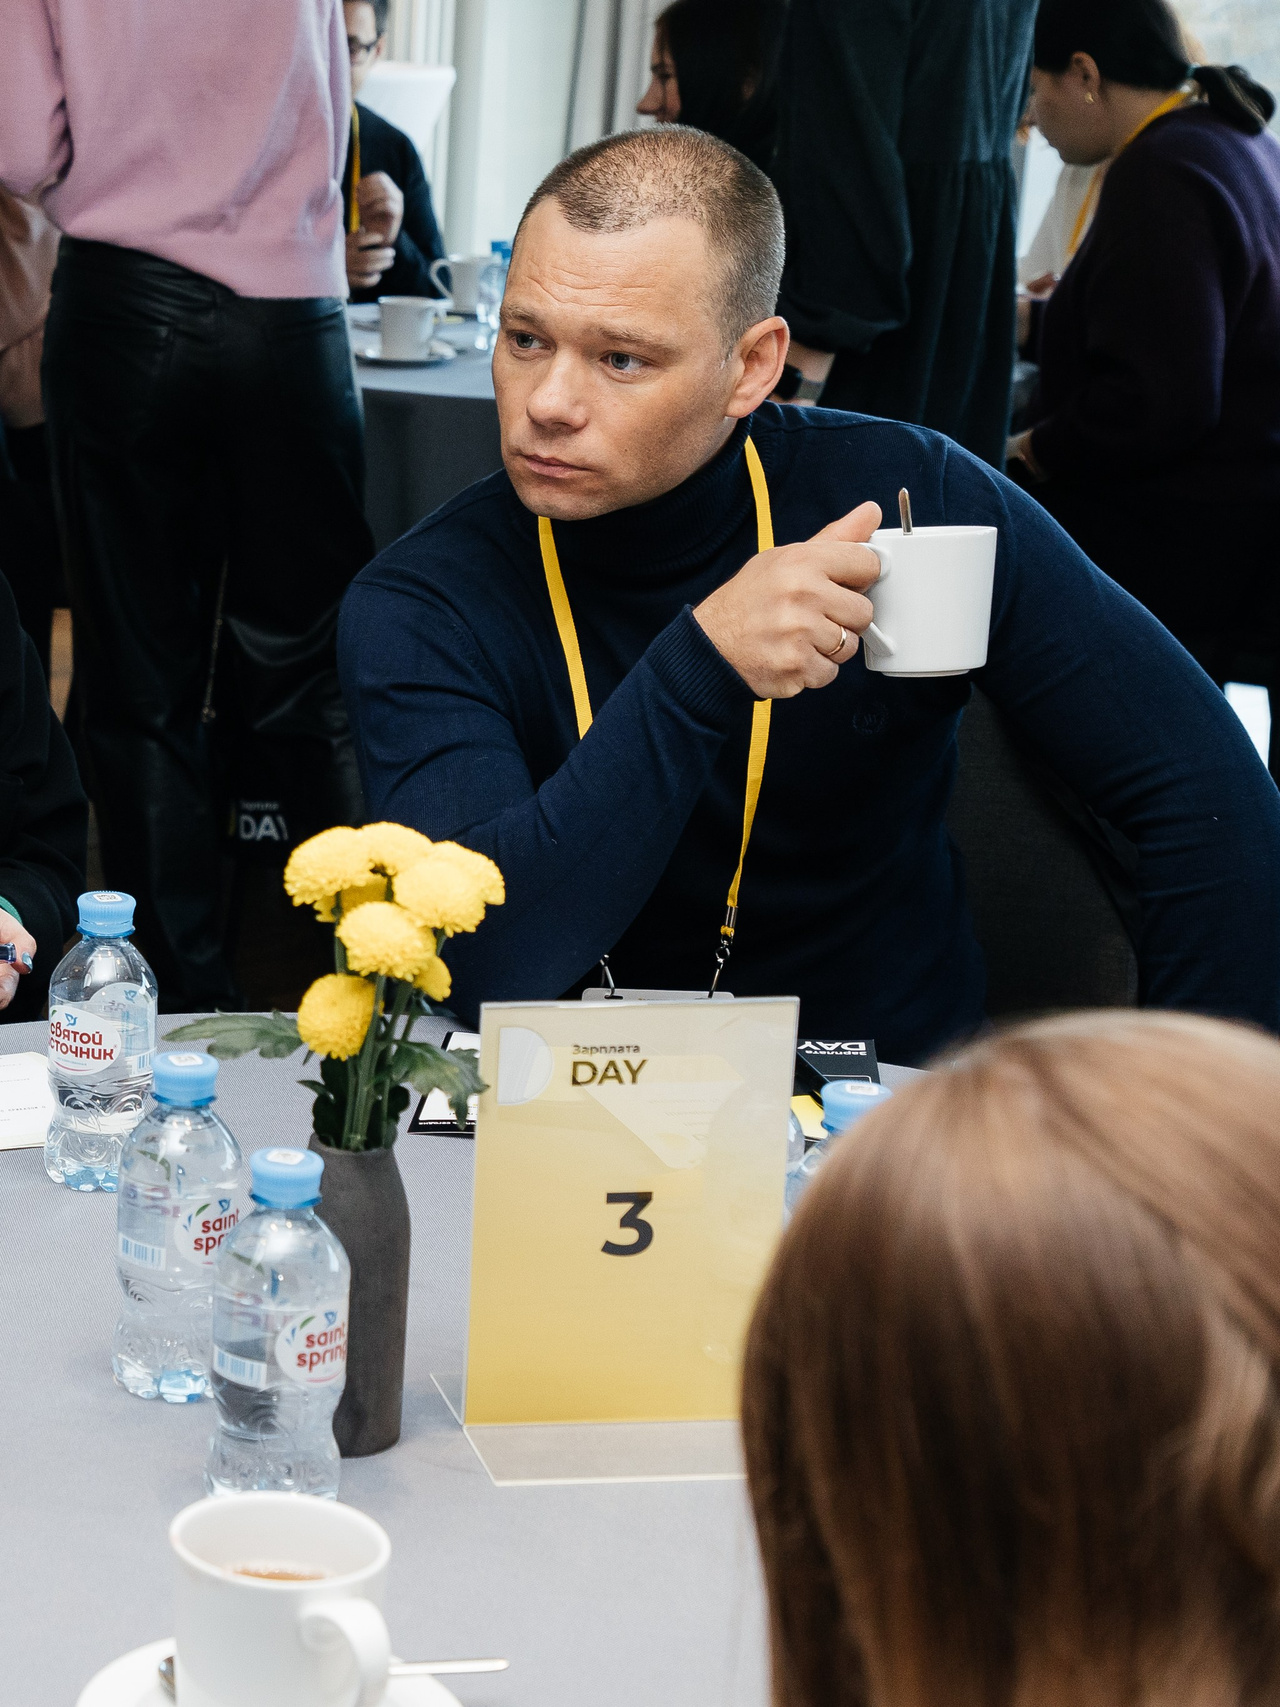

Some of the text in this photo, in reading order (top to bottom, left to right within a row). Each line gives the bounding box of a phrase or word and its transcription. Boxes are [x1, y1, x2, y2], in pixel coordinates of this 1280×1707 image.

[49, 1036, 114, 1060] сточник
[572, 1043, 641, 1057] Зарплата
[797, 1041, 866, 1051] DAY
[571, 1059, 648, 1086] DAY
[201, 1208, 239, 1234] saint
[601, 1191, 653, 1256] 3
[193, 1233, 228, 1256] spr
